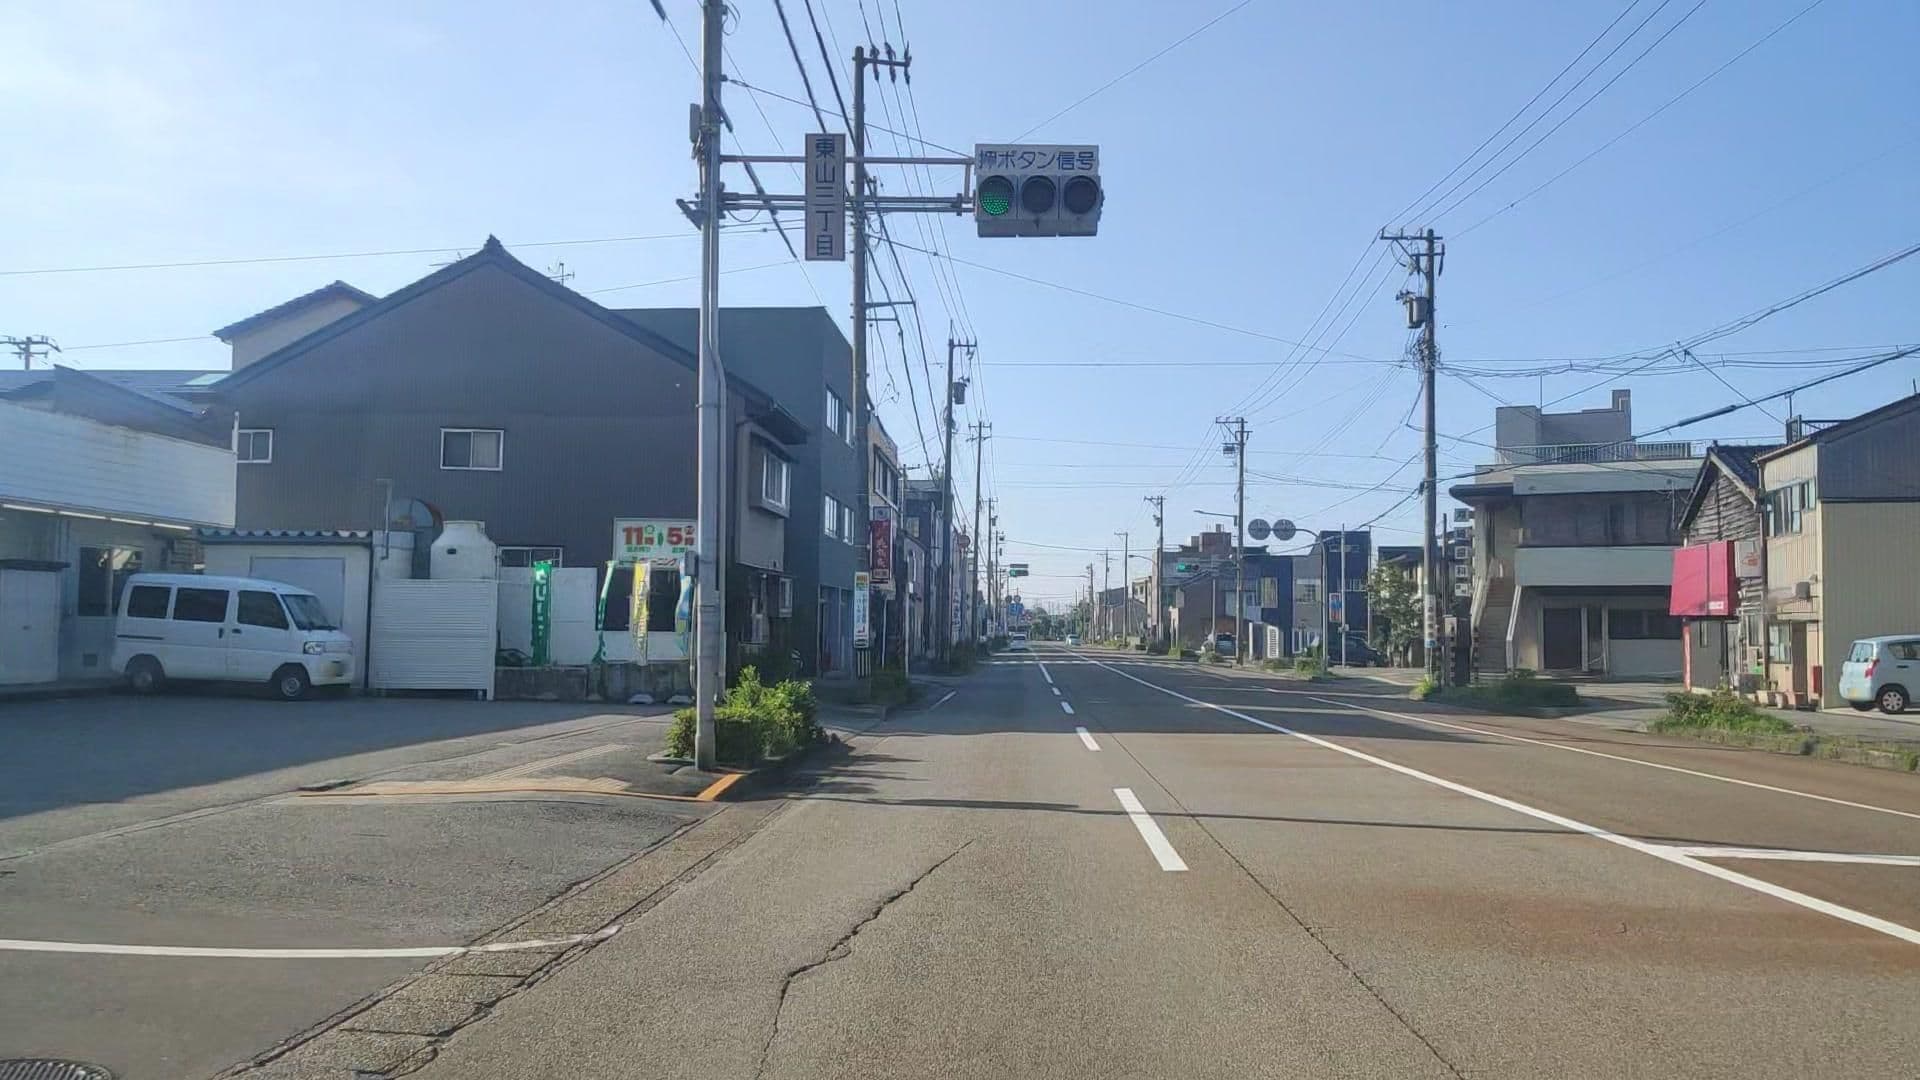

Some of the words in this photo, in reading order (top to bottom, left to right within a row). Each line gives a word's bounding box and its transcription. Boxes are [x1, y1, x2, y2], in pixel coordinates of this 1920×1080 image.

[978, 149, 1096, 171] 押ボタン信号
[815, 138, 836, 256] 東山三丁目
